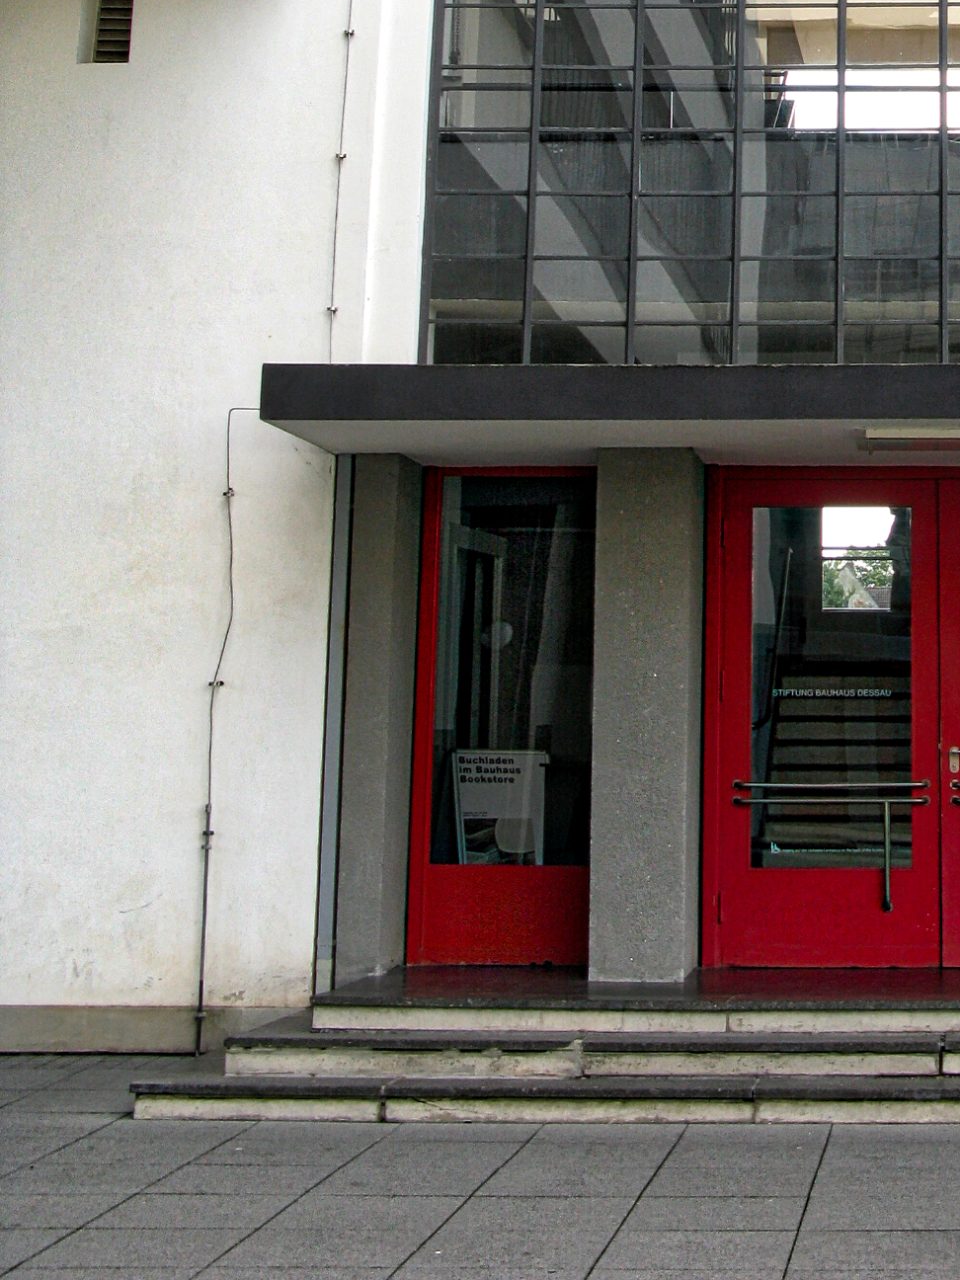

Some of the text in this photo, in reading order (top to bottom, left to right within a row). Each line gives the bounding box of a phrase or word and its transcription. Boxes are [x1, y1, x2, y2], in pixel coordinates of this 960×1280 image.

[772, 688, 892, 697] STIFTUNG BAUHAUS DESSAU
[458, 756, 514, 764] Buchladen
[475, 766, 521, 774] Bauhaus
[459, 775, 515, 783] Bookstore
